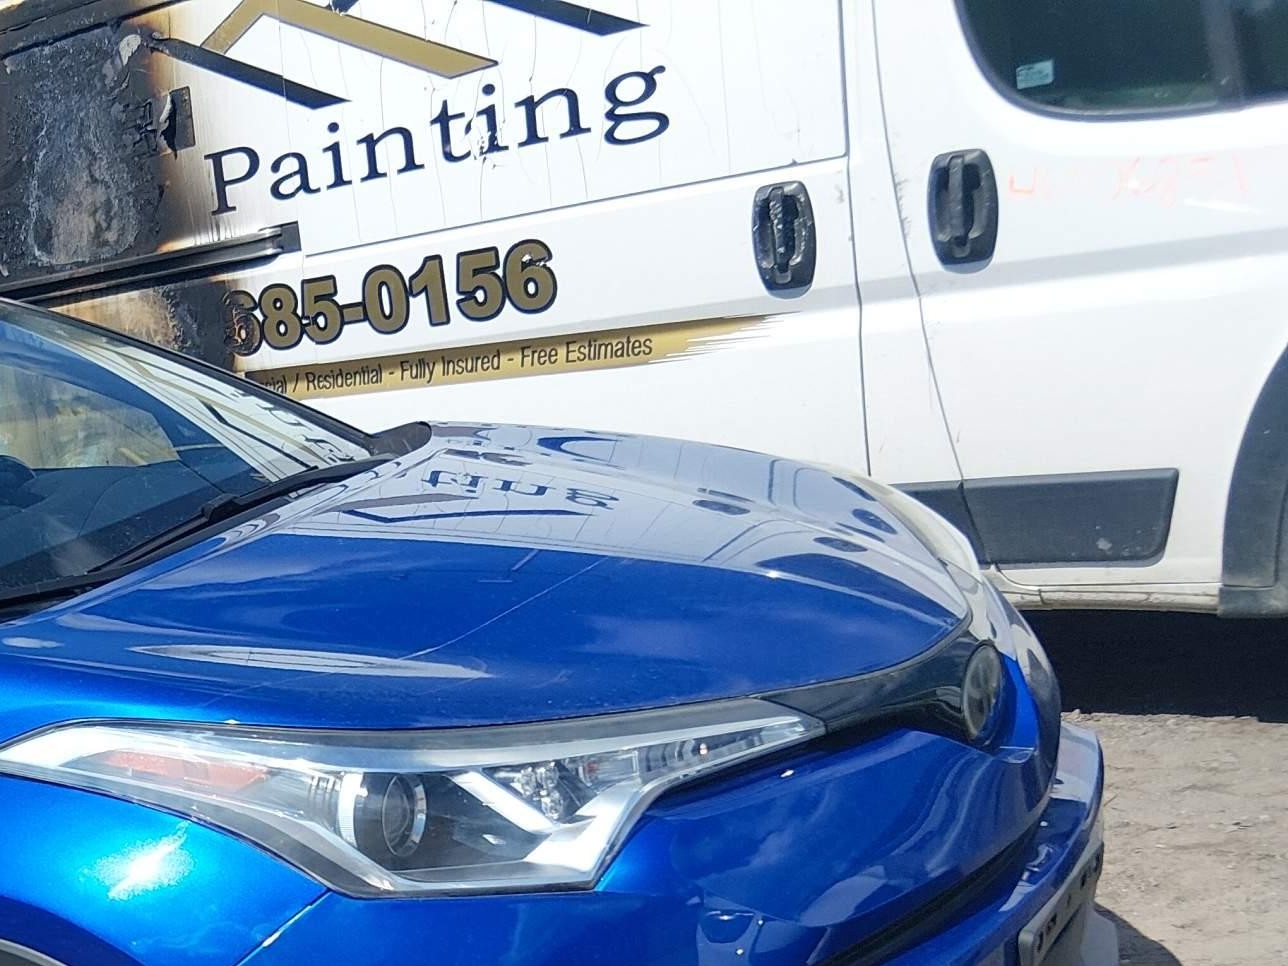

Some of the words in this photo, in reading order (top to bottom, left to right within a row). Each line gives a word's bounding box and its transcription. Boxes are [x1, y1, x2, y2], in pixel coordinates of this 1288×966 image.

[204, 65, 670, 216] Painting
[224, 238, 558, 357] 685-0156
[305, 364, 383, 392] Residential
[400, 358, 436, 384] Fully
[442, 350, 501, 377] Insured
[520, 345, 559, 368] Free
[565, 336, 653, 364] Estimates
